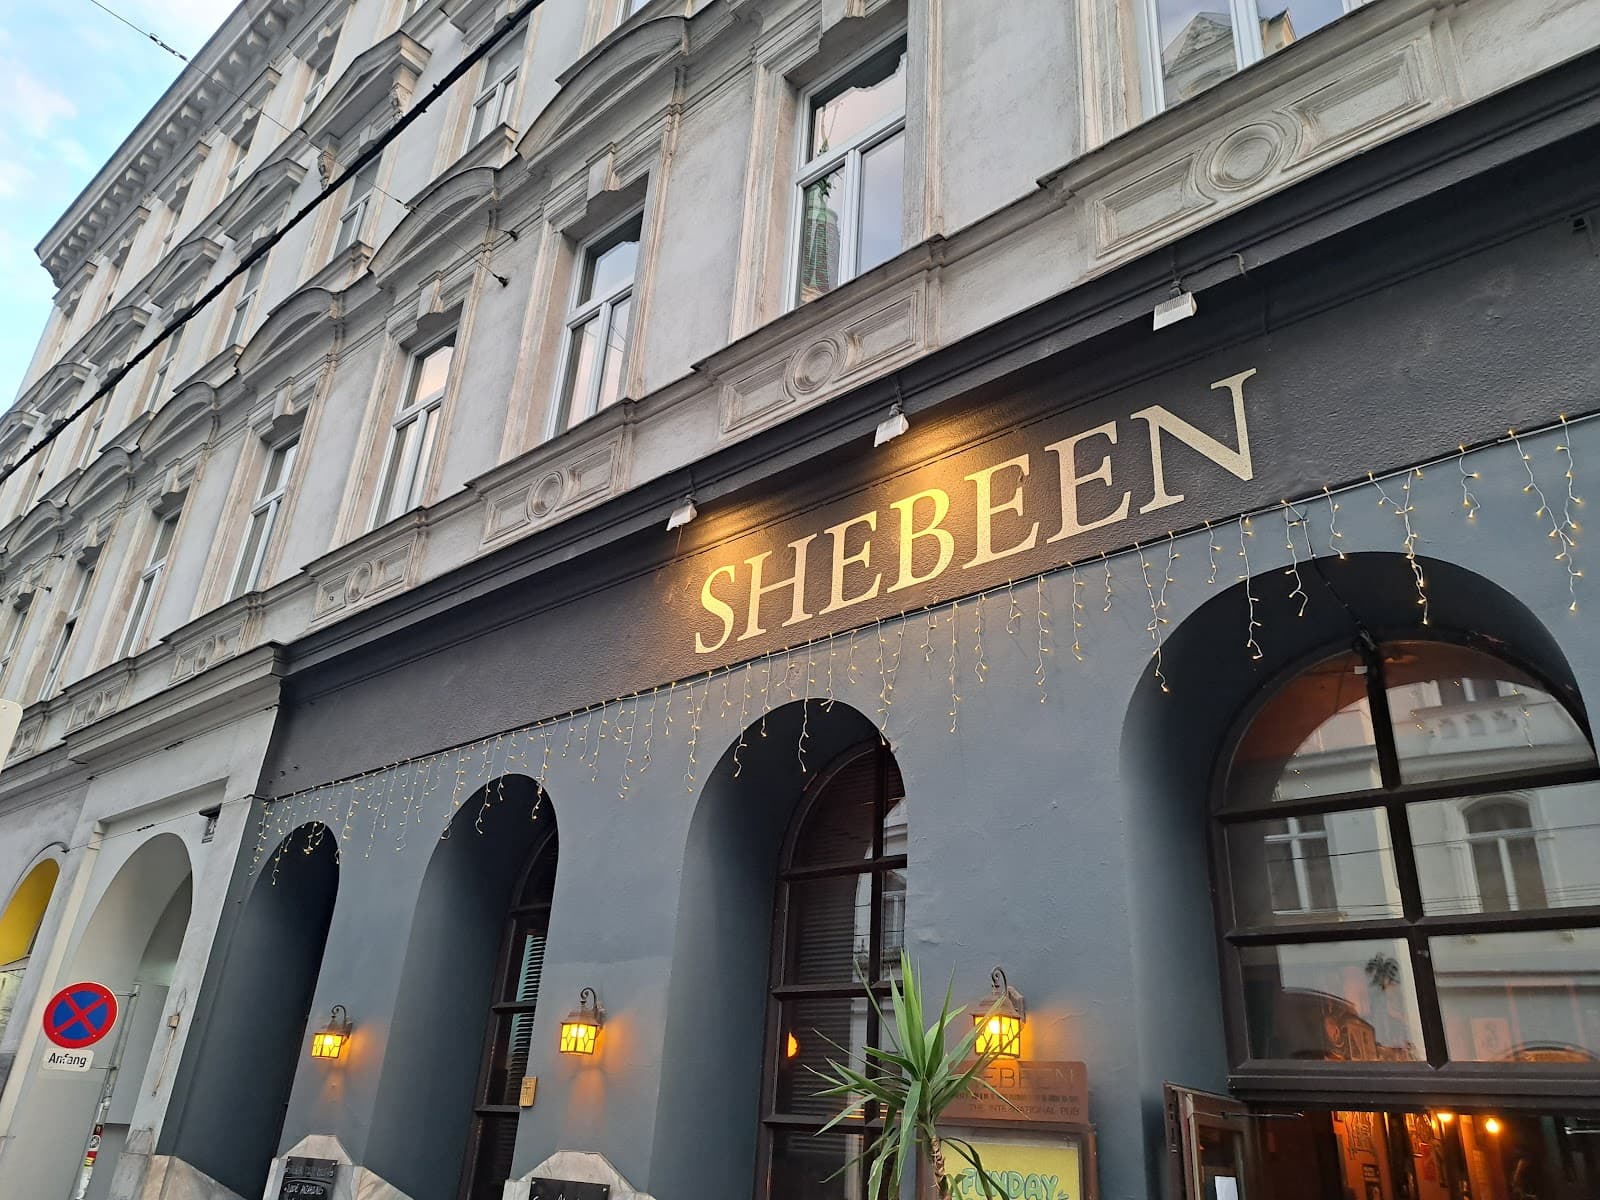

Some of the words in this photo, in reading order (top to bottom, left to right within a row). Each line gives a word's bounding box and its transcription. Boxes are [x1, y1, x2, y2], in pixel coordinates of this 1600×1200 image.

[694, 367, 1257, 655] SHEBEEN
[48, 1053, 87, 1068] Anfang
[980, 1066, 1075, 1090] EBEEN
